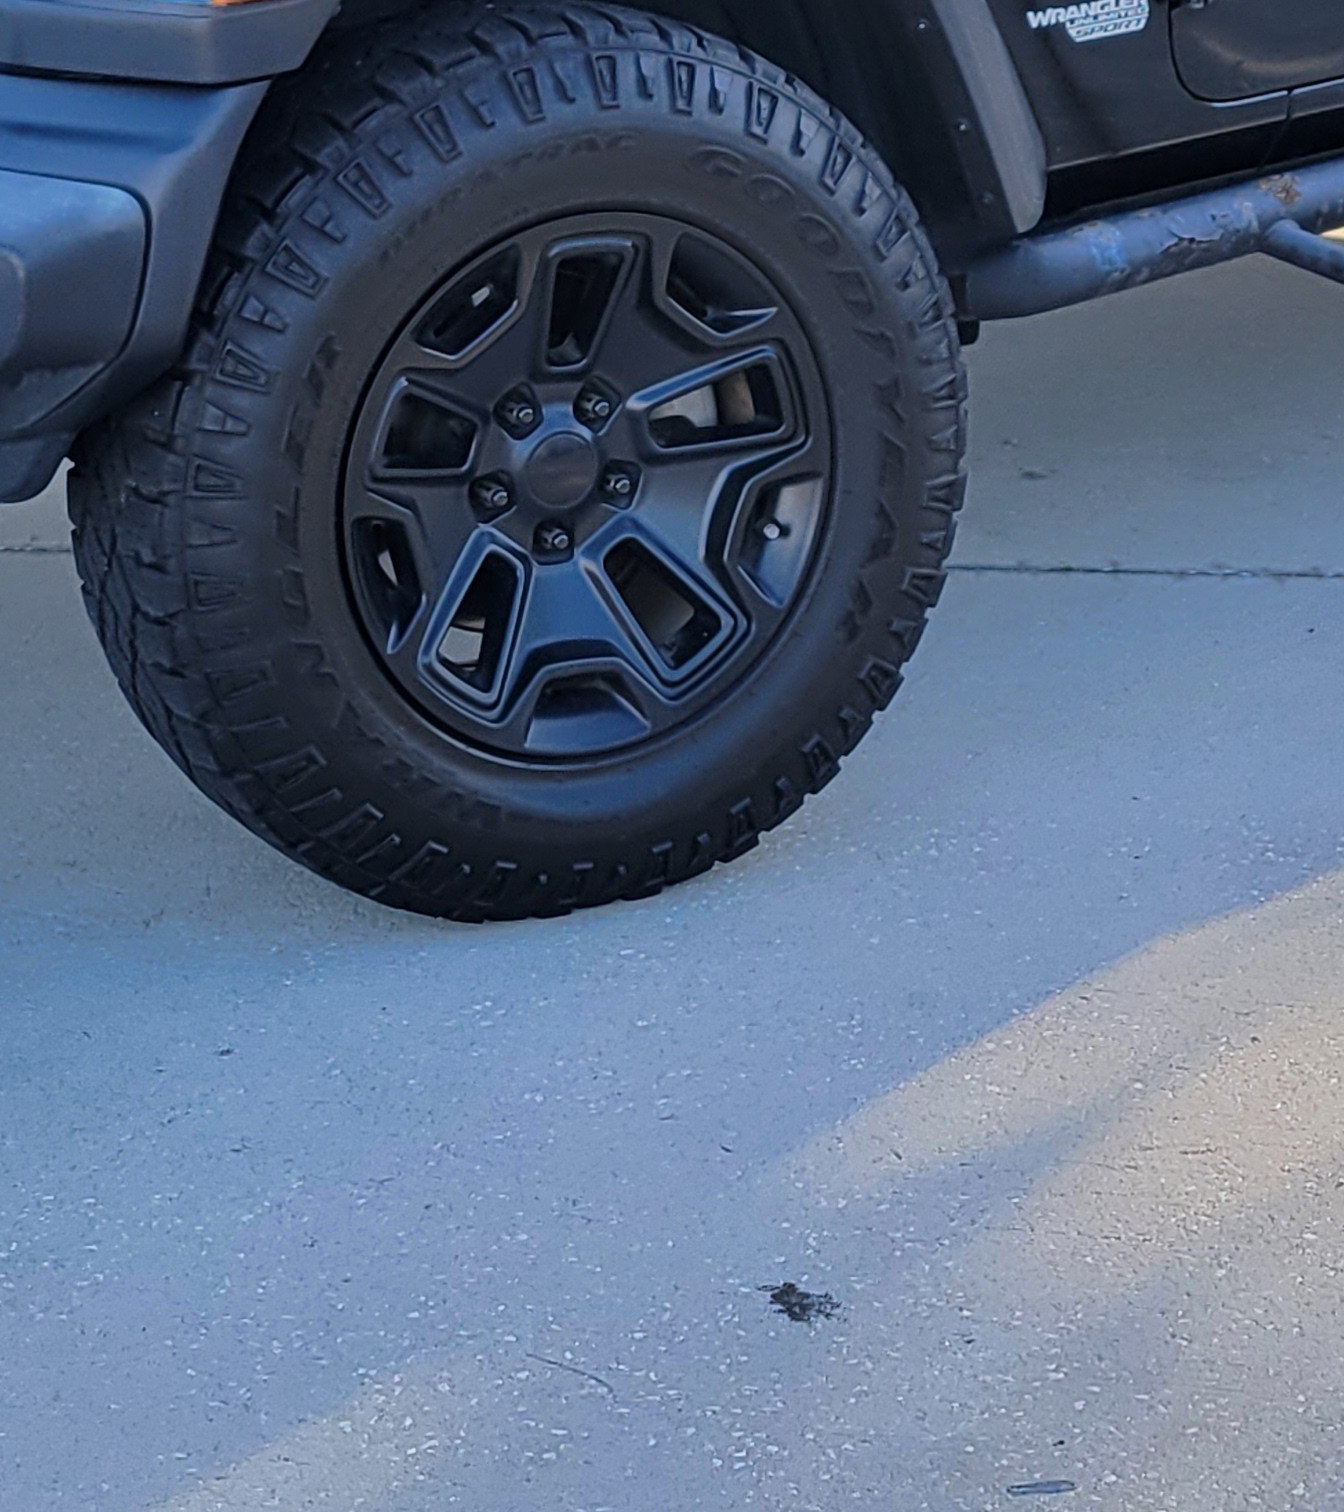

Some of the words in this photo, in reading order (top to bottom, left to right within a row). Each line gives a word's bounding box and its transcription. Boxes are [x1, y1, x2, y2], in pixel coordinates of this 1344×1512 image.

[1066, 6, 1149, 27] UNLIMITED
[1074, 16, 1144, 38] SPORT
[687, 145, 908, 646] GOODYEAR
